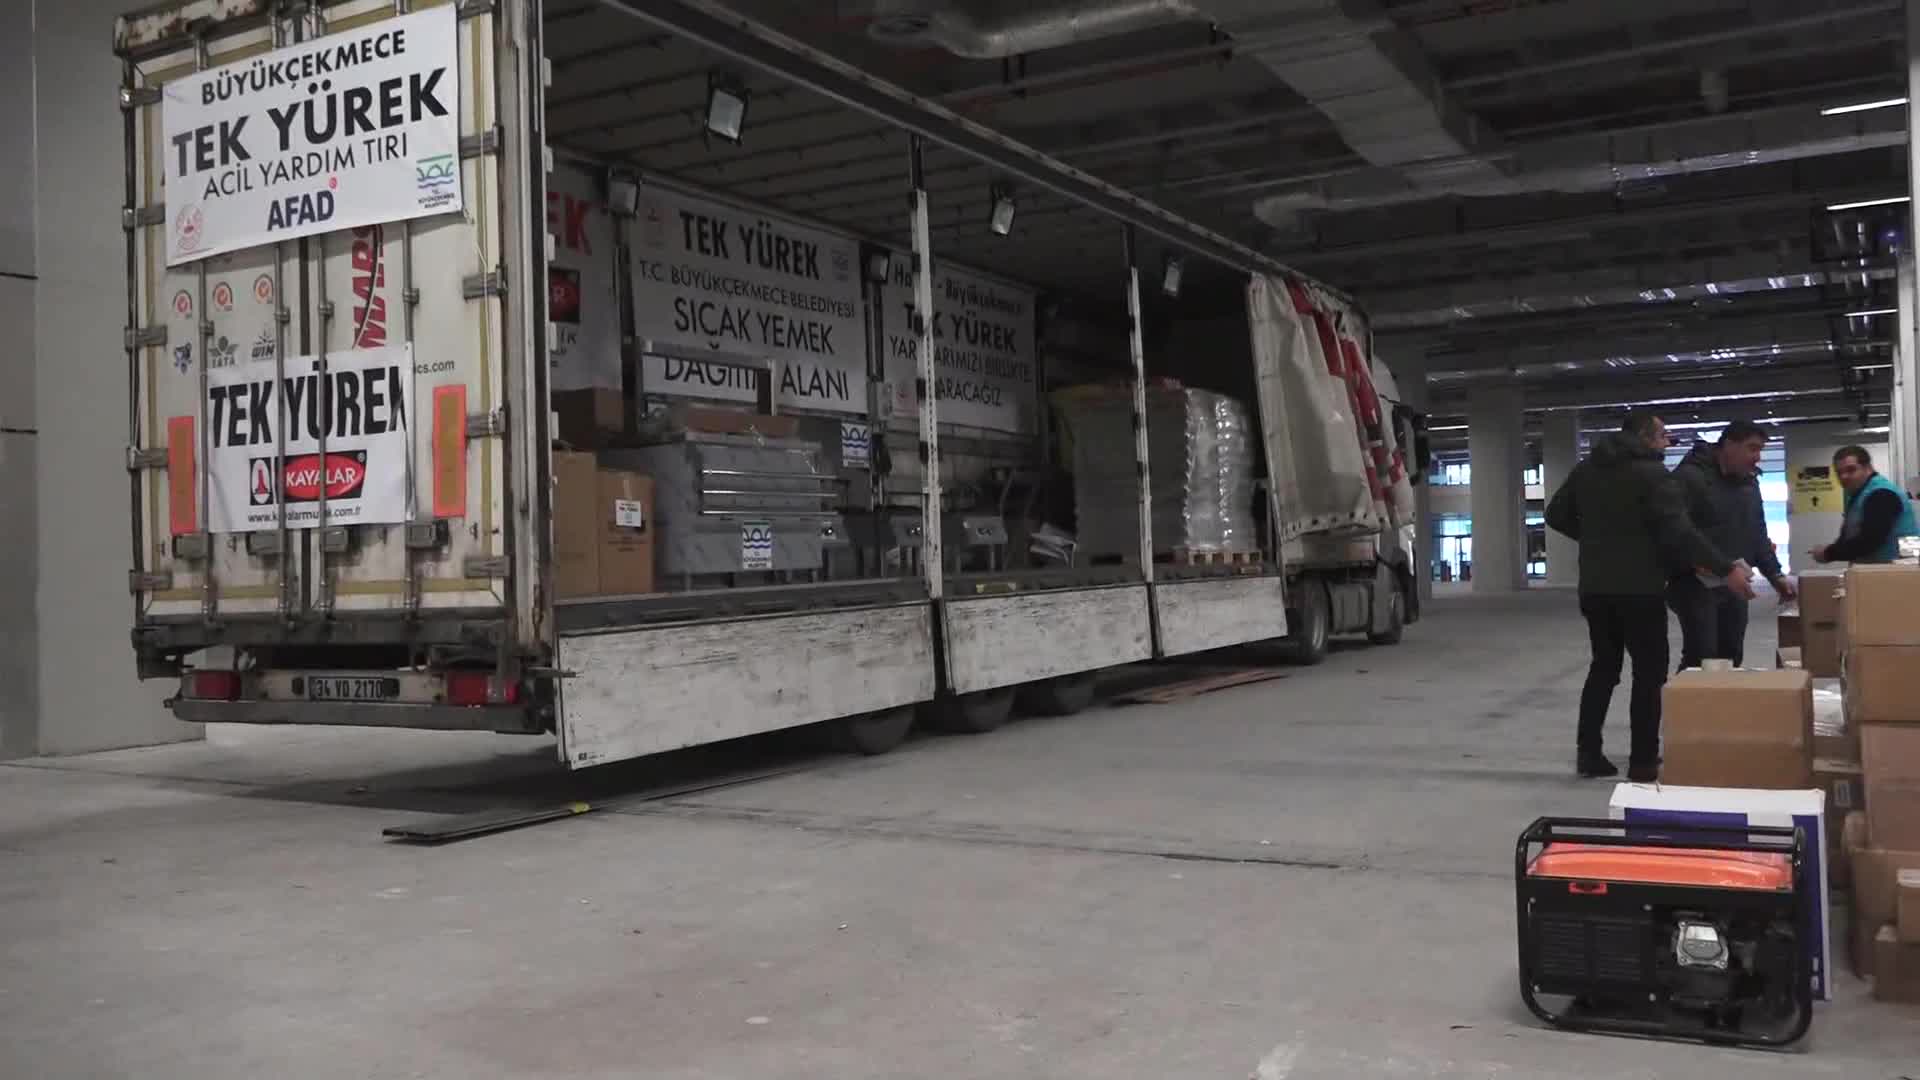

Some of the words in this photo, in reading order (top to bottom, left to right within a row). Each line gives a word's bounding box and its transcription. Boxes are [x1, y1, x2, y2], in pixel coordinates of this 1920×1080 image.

[202, 30, 405, 105] BÜYÜKÇEKMECE
[172, 116, 251, 177] TEK
[267, 67, 449, 151] YÜREK
[203, 163, 253, 200] ACİL
[259, 145, 355, 188] YARDIM
[363, 133, 408, 162] TIRI
[267, 190, 335, 231] AFAD
[679, 210, 729, 259] TEK
[739, 220, 820, 280] YÜREK
[674, 296, 752, 342] SICAK
[757, 312, 834, 354] YEMEK
[950, 311, 1017, 353] YÜREK
[780, 361, 849, 400] ALANI
[210, 380, 272, 448] TEK
[286, 467, 356, 487] KAYALAR
